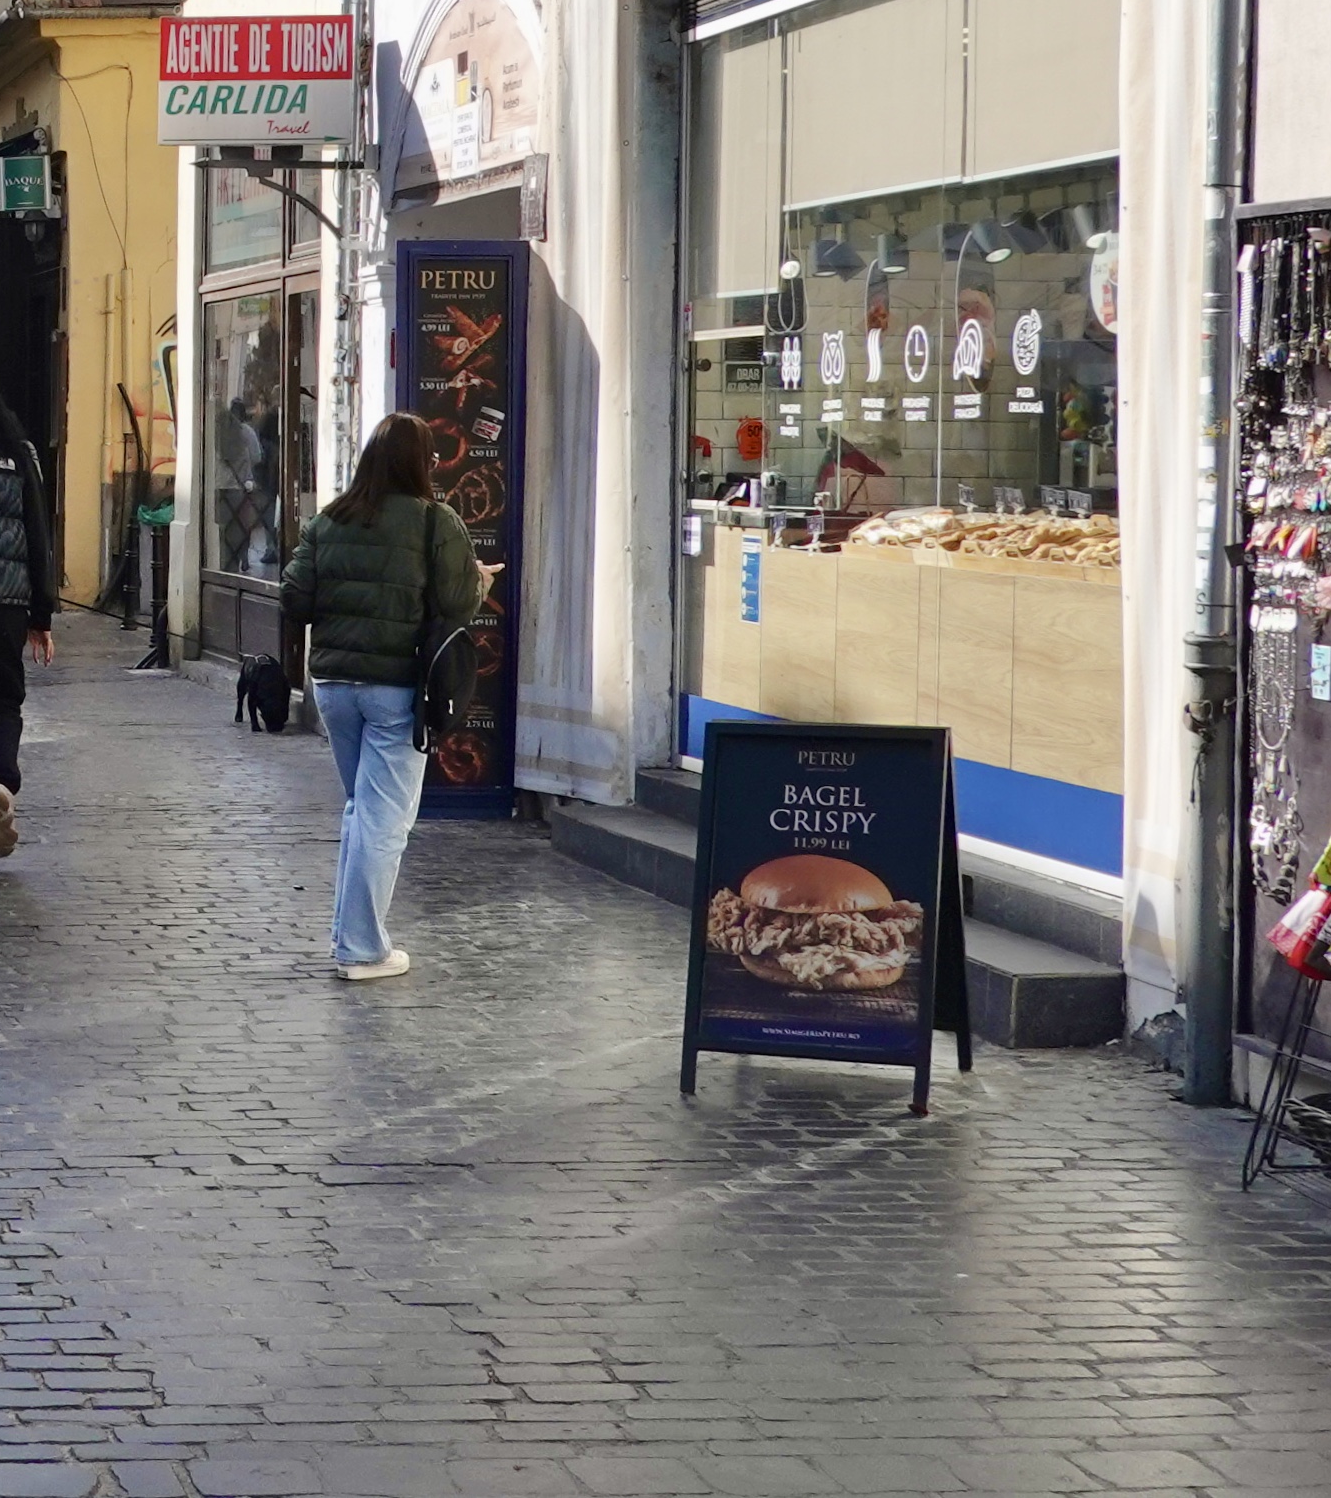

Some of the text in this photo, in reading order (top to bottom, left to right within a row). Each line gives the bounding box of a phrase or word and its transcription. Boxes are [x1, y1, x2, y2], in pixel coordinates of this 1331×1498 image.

[165, 22, 348, 73] AGENTIE DE TURISM
[165, 84, 308, 115] CARLIDA
[267, 120, 311, 134] Travel
[420, 270, 496, 290] PETRU
[437, 324, 450, 332] LEI
[485, 449, 498, 457] LEI
[798, 750, 856, 766] PETRU
[783, 784, 866, 807] BAGEL
[769, 808, 877, 834] CRISPY
[794, 836, 850, 850] 11.99 LEI
